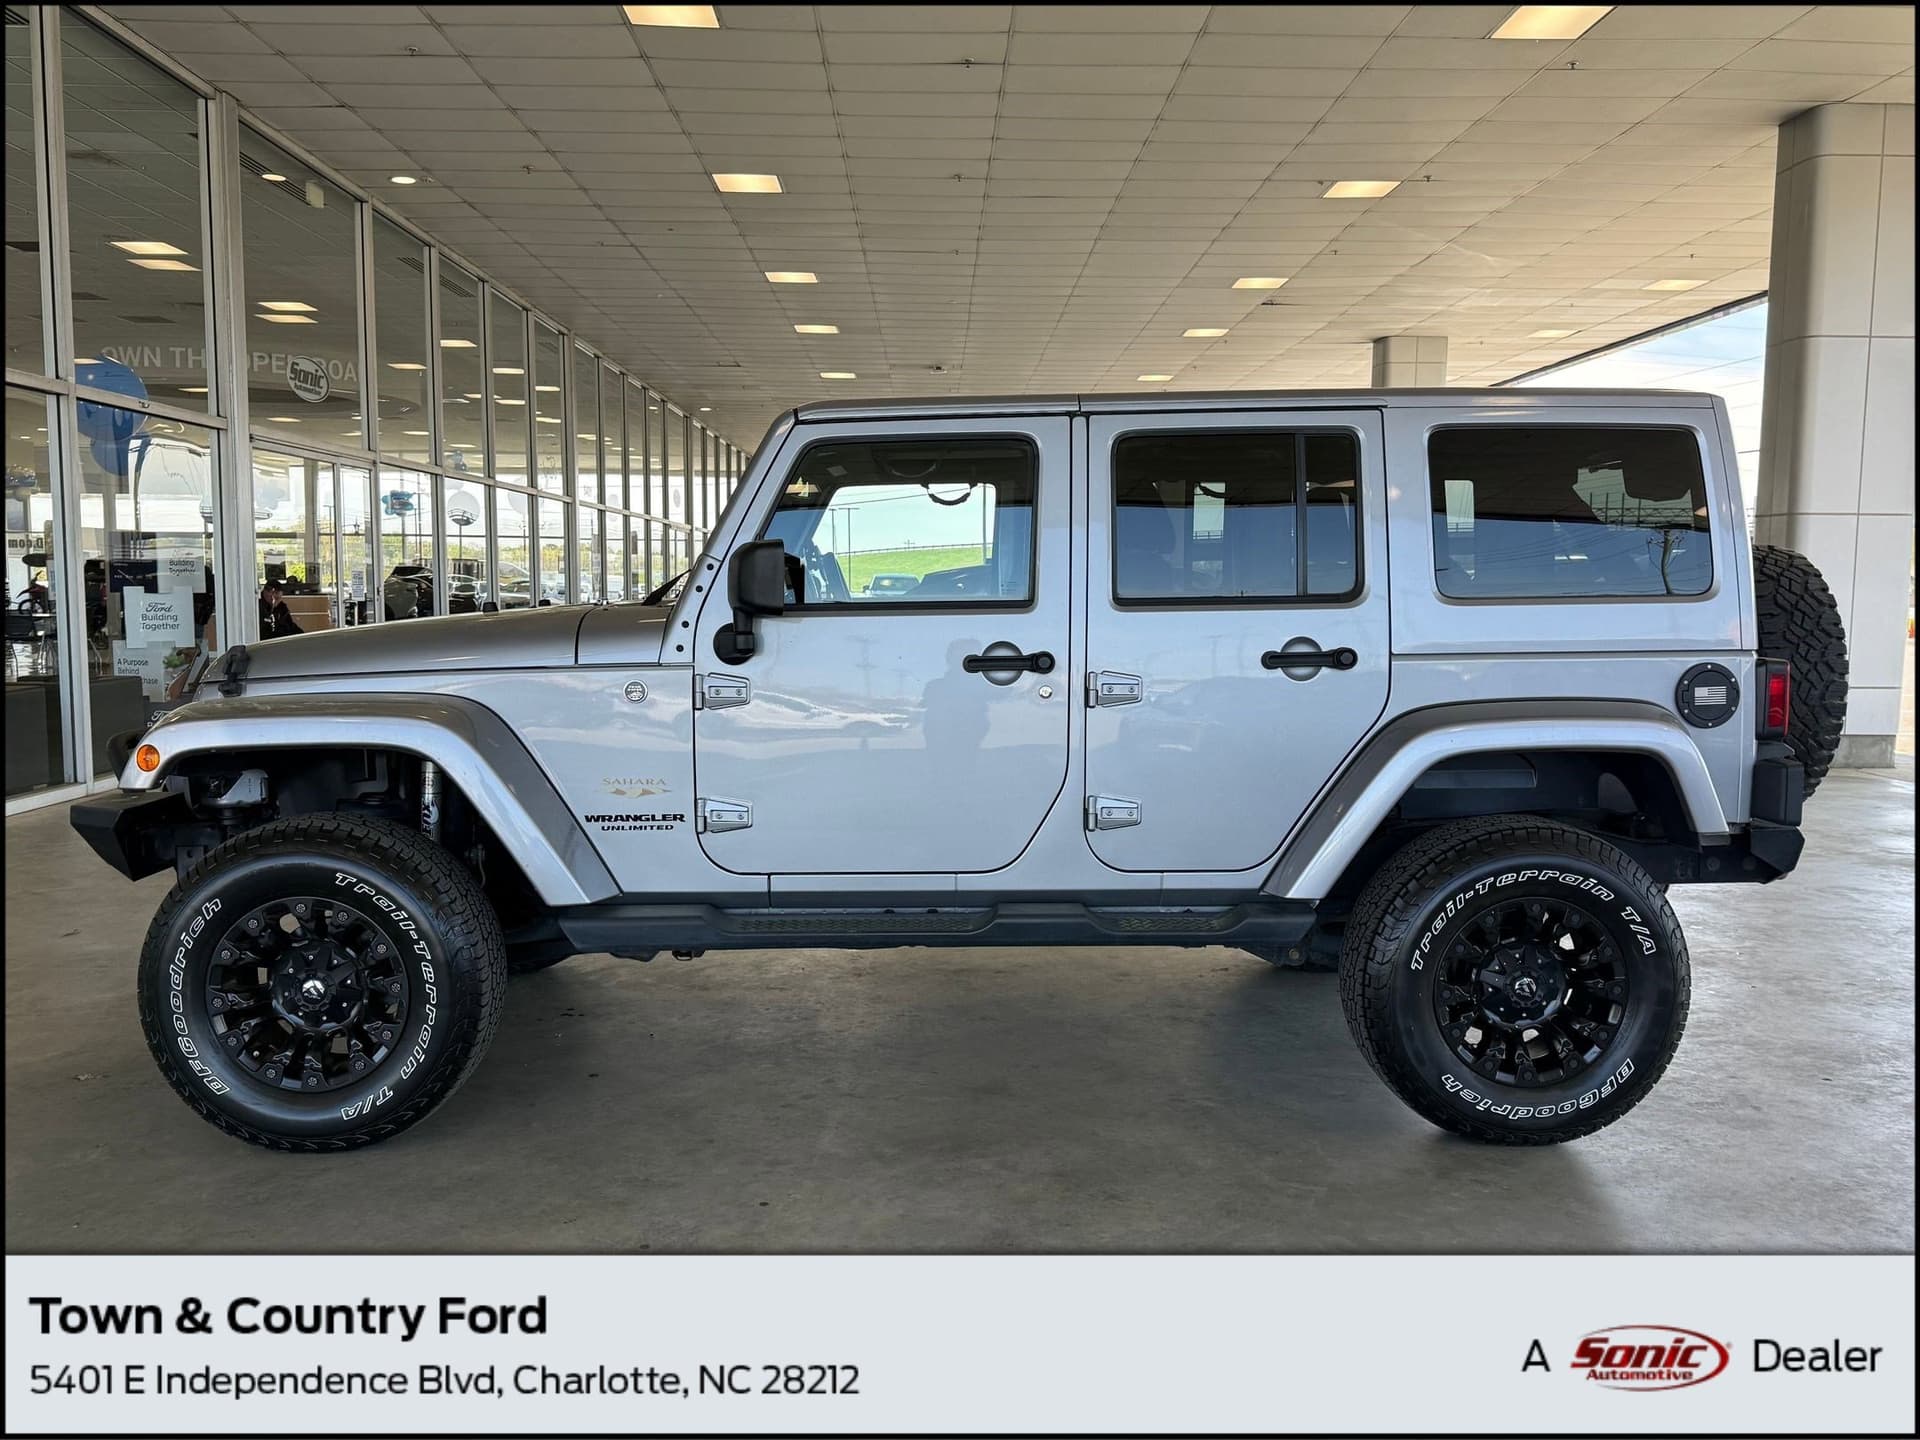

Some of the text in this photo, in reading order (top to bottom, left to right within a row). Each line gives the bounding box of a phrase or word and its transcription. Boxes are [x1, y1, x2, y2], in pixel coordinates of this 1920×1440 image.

[100, 346, 161, 368] OWN
[169, 347, 207, 369] TH
[246, 351, 290, 375] PE
[289, 361, 325, 390] Sonic
[169, 559, 195, 568] Building
[169, 567, 196, 576] Together
[145, 602, 174, 613] Ford
[141, 613, 178, 622] Building
[141, 622, 180, 631] Together
[117, 658, 149, 667] A Purpose
[118, 667, 140, 675] Behind
[602, 777, 667, 786] SAHARA
[584, 813, 686, 823] WRANGLER
[1410, 869, 1657, 971] Trail-Terrain T/A
[169, 897, 231, 1096] BFGoodrich
[334, 871, 437, 1121] Trail-Terrain T/A
[1441, 1057, 1636, 1120] BFGoodrich
